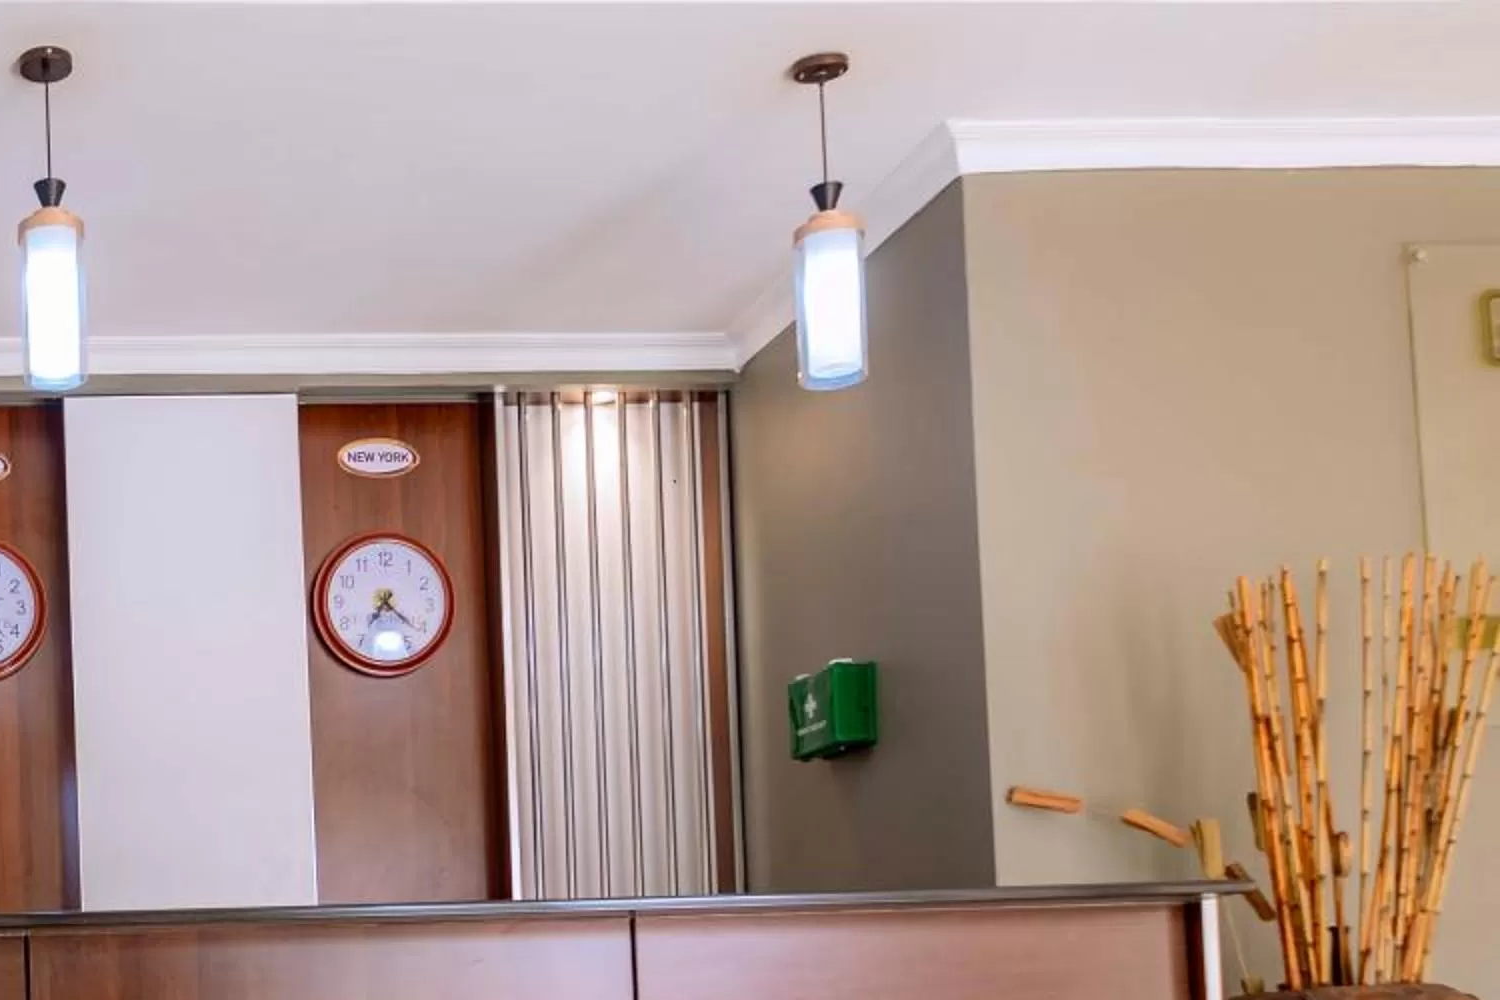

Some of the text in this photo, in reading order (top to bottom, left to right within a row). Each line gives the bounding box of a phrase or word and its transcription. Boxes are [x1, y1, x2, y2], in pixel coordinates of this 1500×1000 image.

[347, 451, 410, 463] NEW YORK
[355, 558, 368, 573] 11
[377, 552, 393, 568] 12
[405, 560, 412, 575] 1
[9, 578, 21, 593] 2
[339, 575, 355, 590] 10
[419, 576, 430, 591] 2
[16, 600, 27, 616] 3
[333, 595, 345, 610] 9
[425, 597, 436, 613] 3
[340, 615, 350, 631] 8
[8, 623, 20, 639] 4
[355, 633, 366, 648] 7
